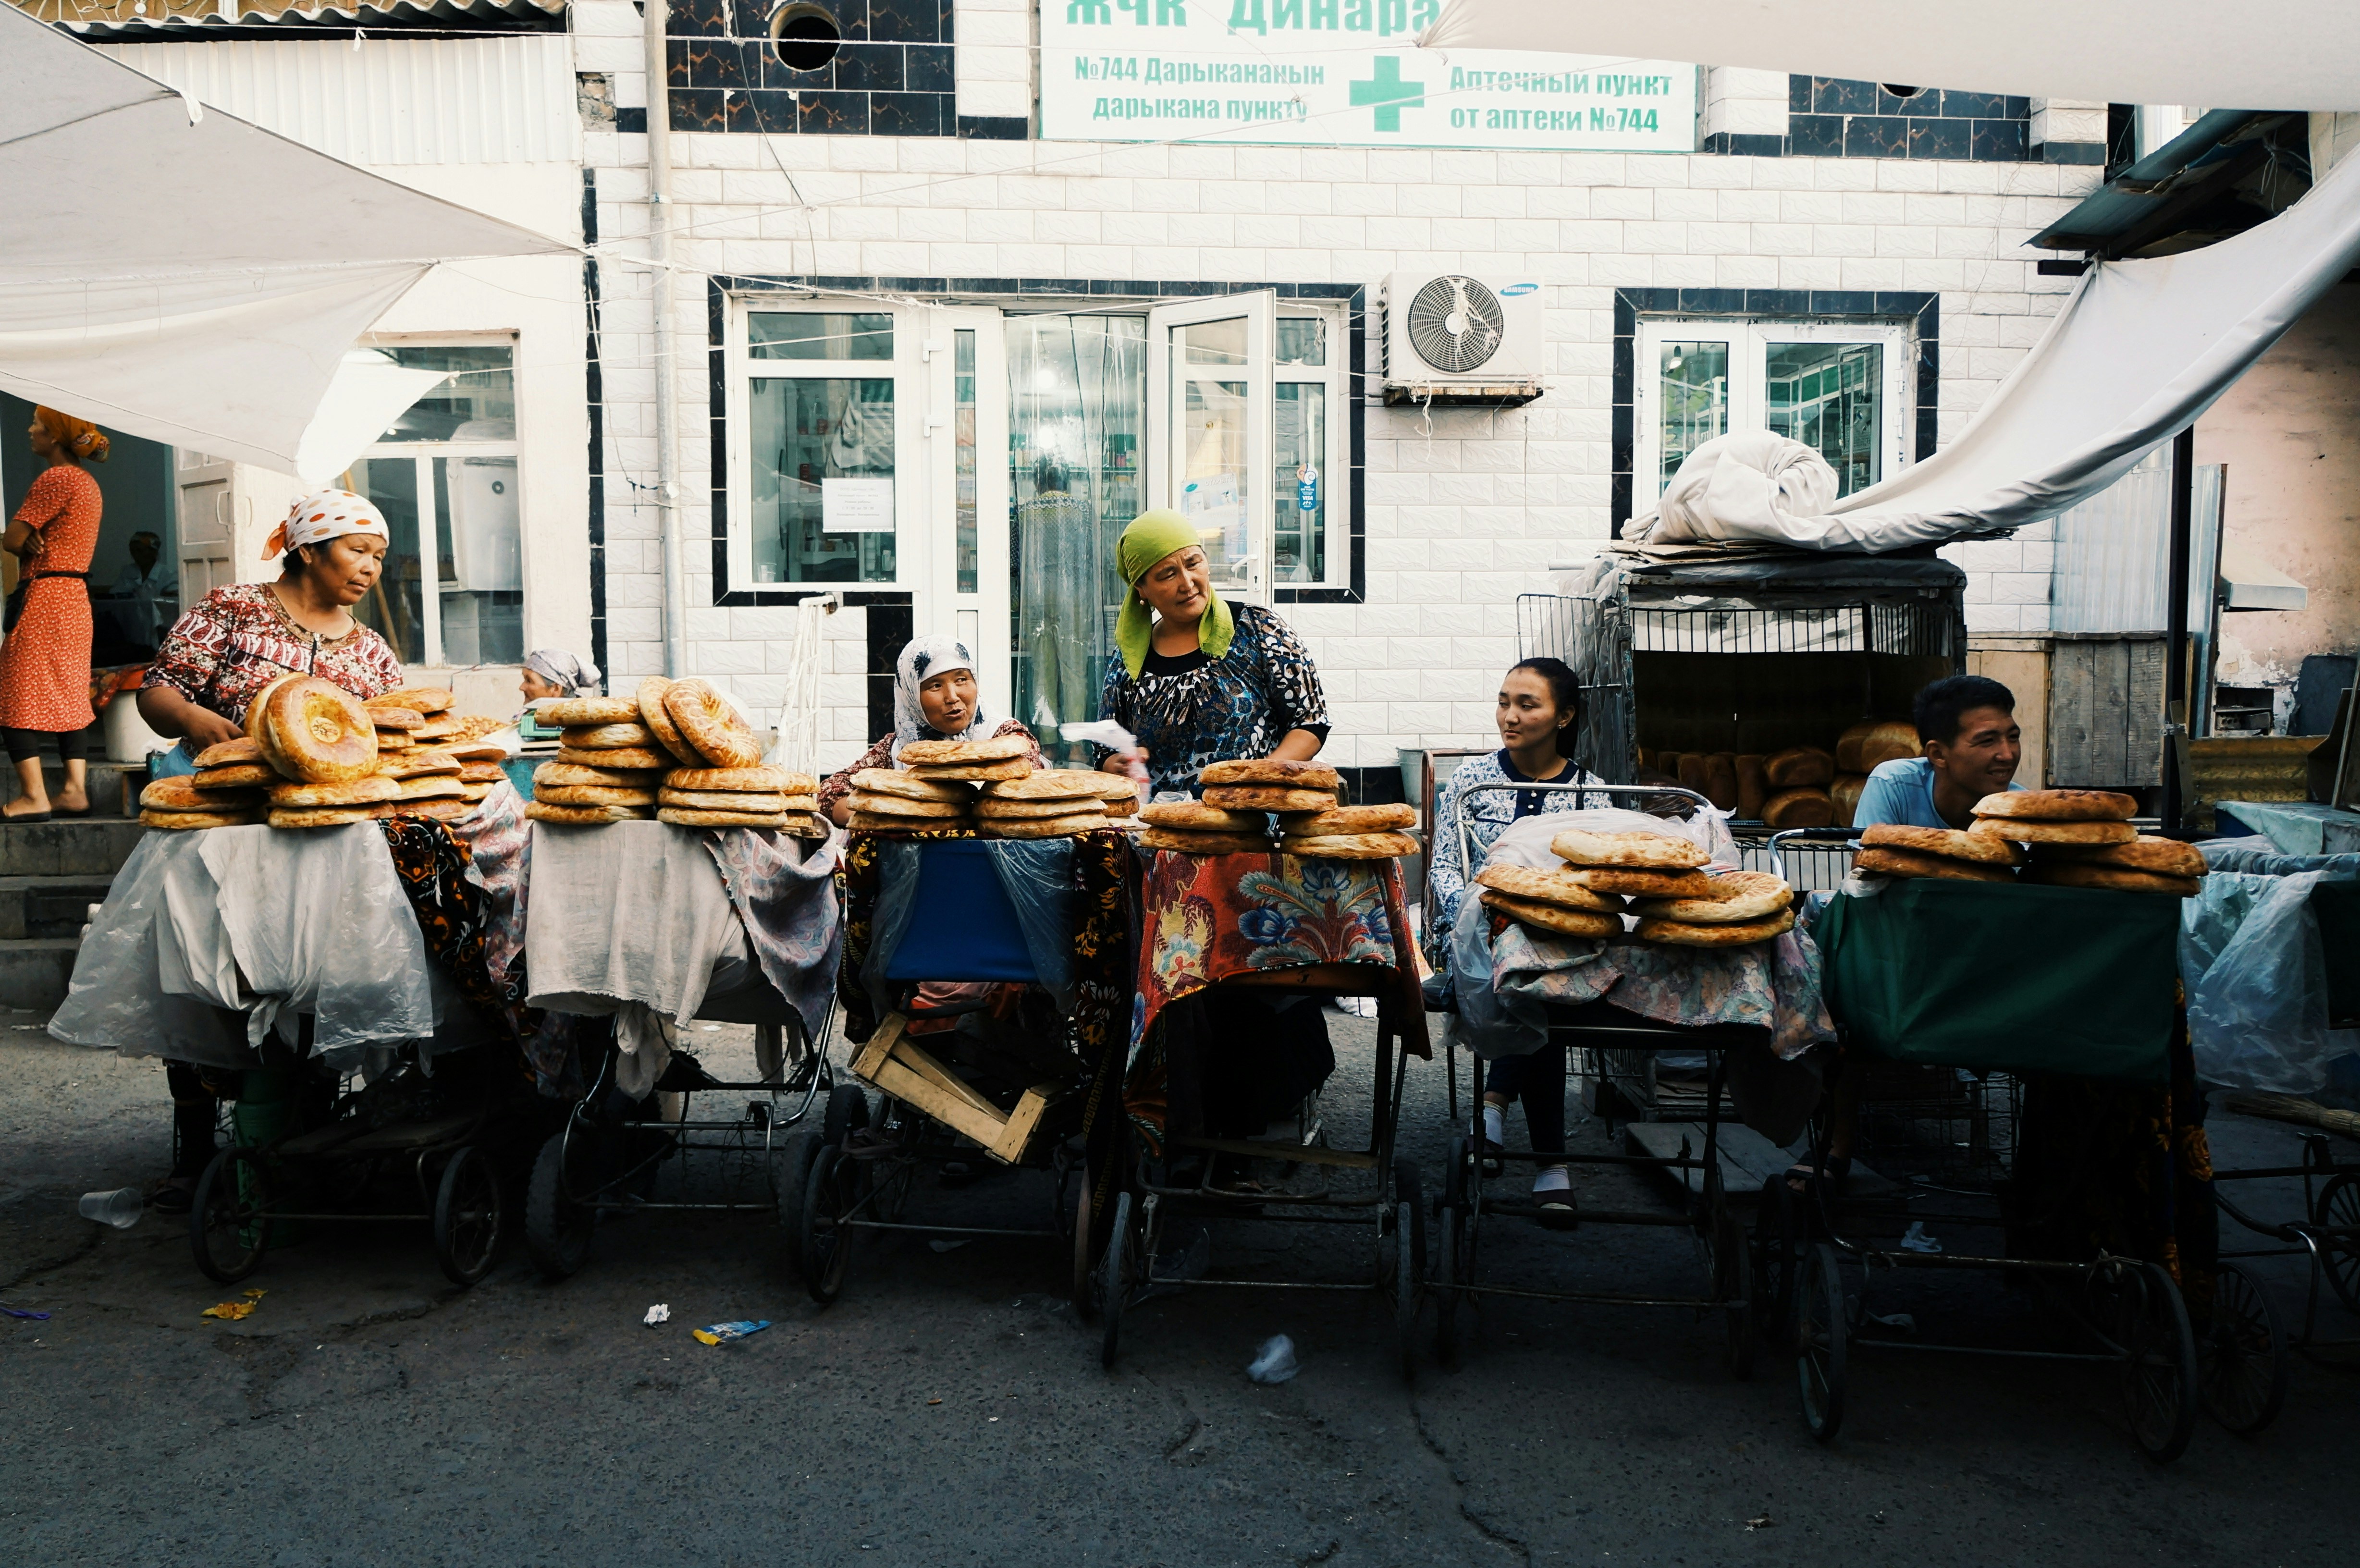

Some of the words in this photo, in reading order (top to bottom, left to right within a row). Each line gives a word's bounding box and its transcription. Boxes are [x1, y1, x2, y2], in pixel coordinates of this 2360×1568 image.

[1075, 56, 1139, 80] №744
[1144, 58, 1324, 85] Дарыкананын
[1450, 66, 1589, 94] Аптечный
[1596, 74, 1672, 97] пункт
[1093, 97, 1220, 121] дарыкана
[1227, 99, 1307, 123] пункту
[1450, 108, 1479, 128] от
[1487, 108, 1582, 131] аптеки
[1589, 107, 1659, 133] №744
